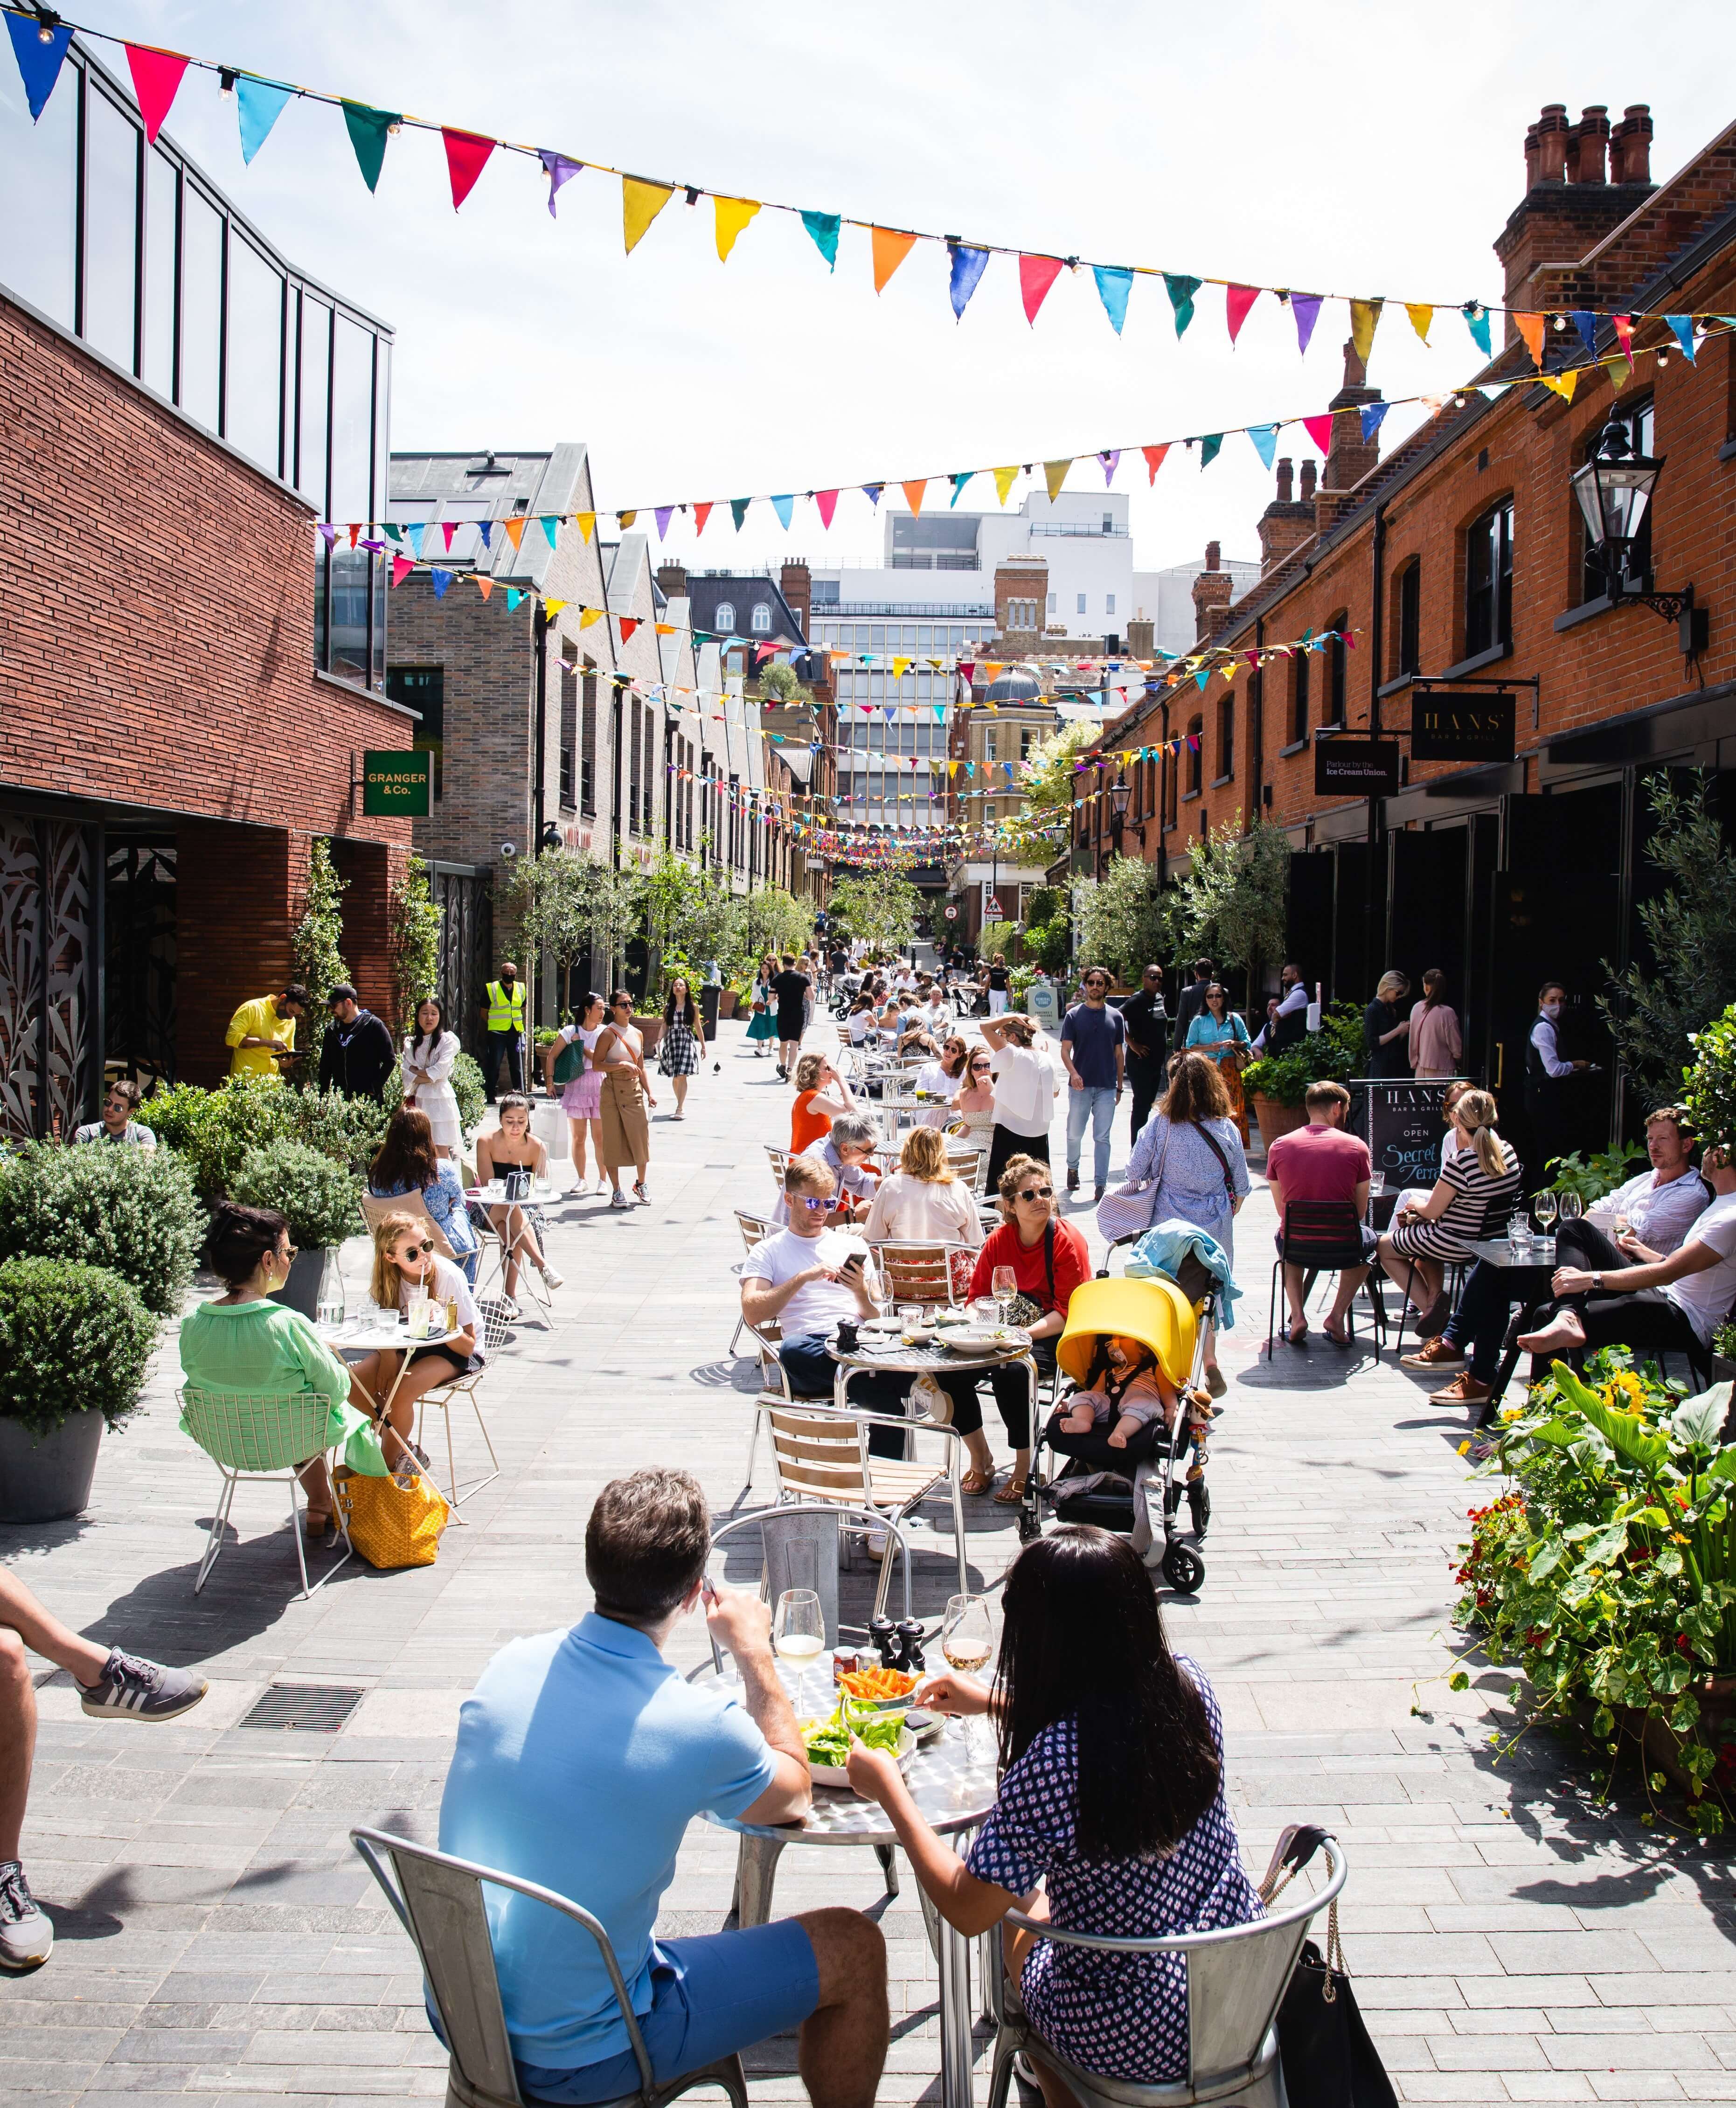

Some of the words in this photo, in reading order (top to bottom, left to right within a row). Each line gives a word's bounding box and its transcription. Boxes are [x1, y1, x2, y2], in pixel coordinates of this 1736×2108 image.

[1424, 713, 1504, 730] HANS'
[368, 773, 426, 783] GRANGER
[384, 785, 391, 794] &
[393, 785, 411, 794] Co.
[1387, 1090, 1445, 1103] HANS
[1382, 1143, 1436, 1167] Secret
